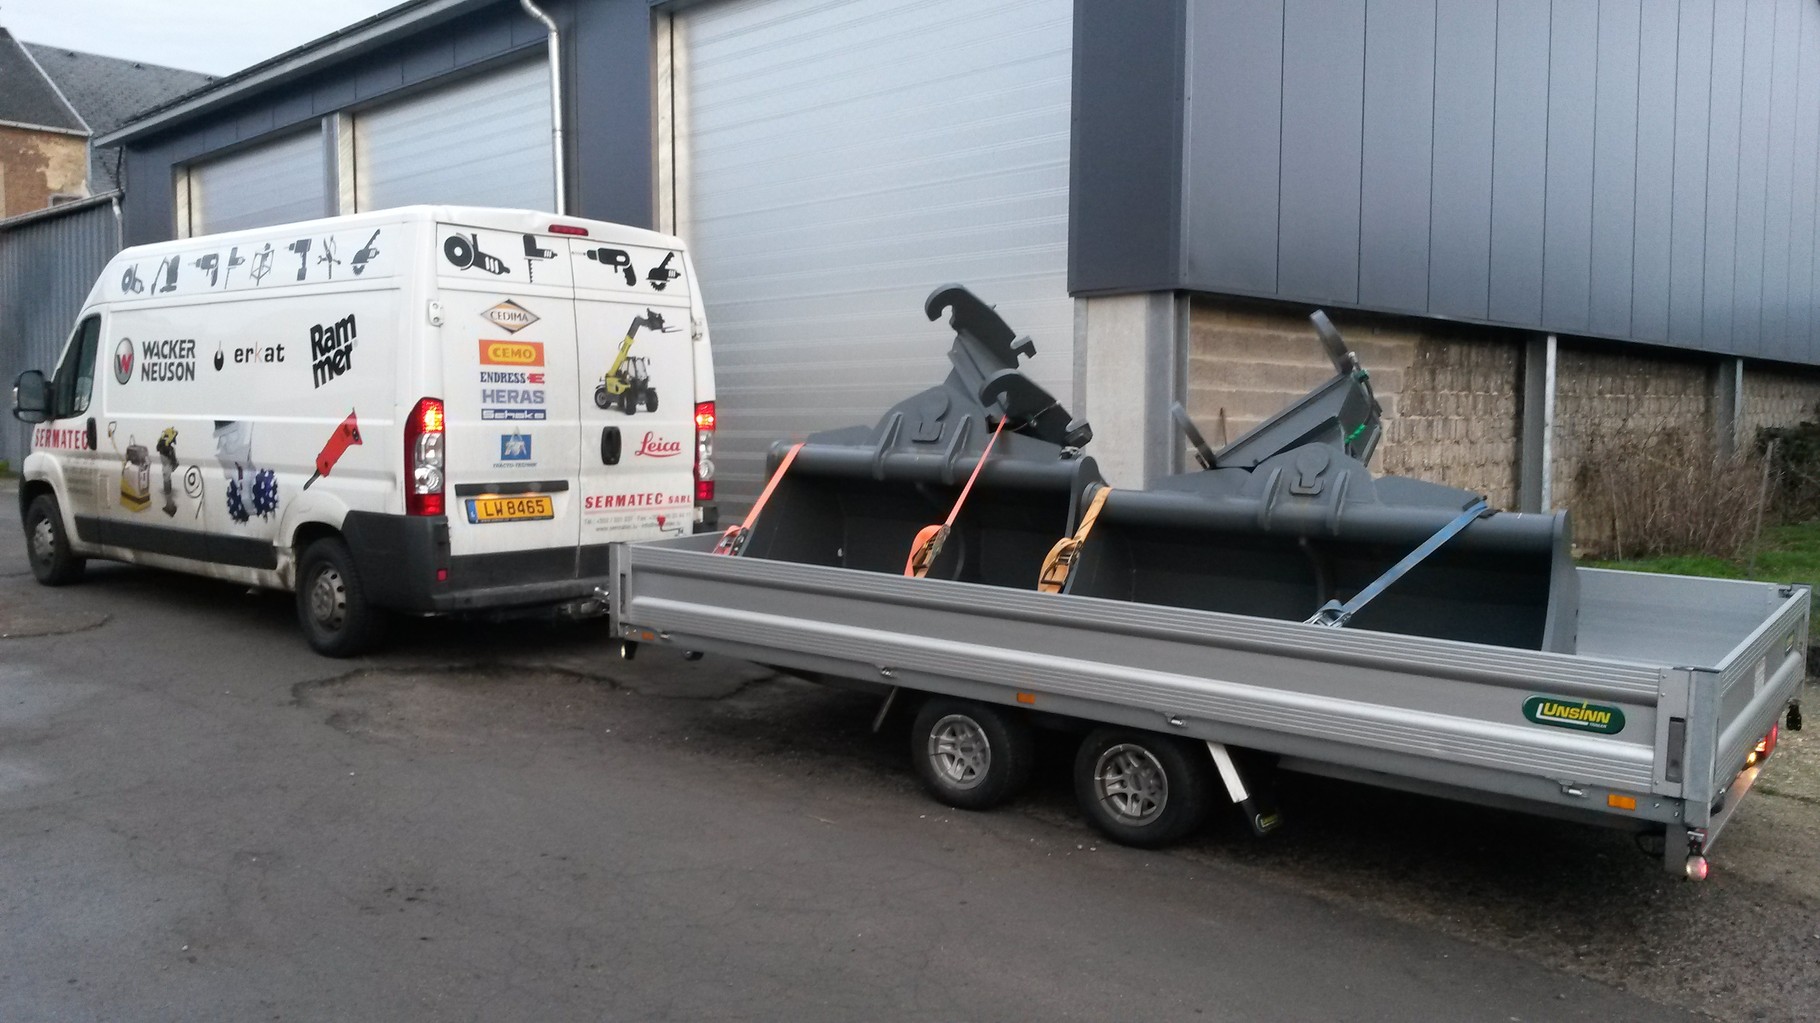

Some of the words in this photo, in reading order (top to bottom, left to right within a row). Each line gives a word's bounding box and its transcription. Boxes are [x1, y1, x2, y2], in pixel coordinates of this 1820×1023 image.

[490, 310, 529, 322] CEDIMA
[310, 313, 357, 362] Ram
[142, 339, 196, 360] WACKER
[234, 341, 285, 363] erkat
[492, 347, 533, 360] CEMO
[141, 361, 196, 382] NEUSON
[312, 342, 353, 389] mer
[480, 371, 526, 384] ENDRESS
[482, 389, 545, 404] HERAS
[35, 428, 88, 451] SERMATEC
[634, 431, 681, 458] Leica
[584, 492, 664, 510] SERMATEC
[668, 495, 692, 504] SARL
